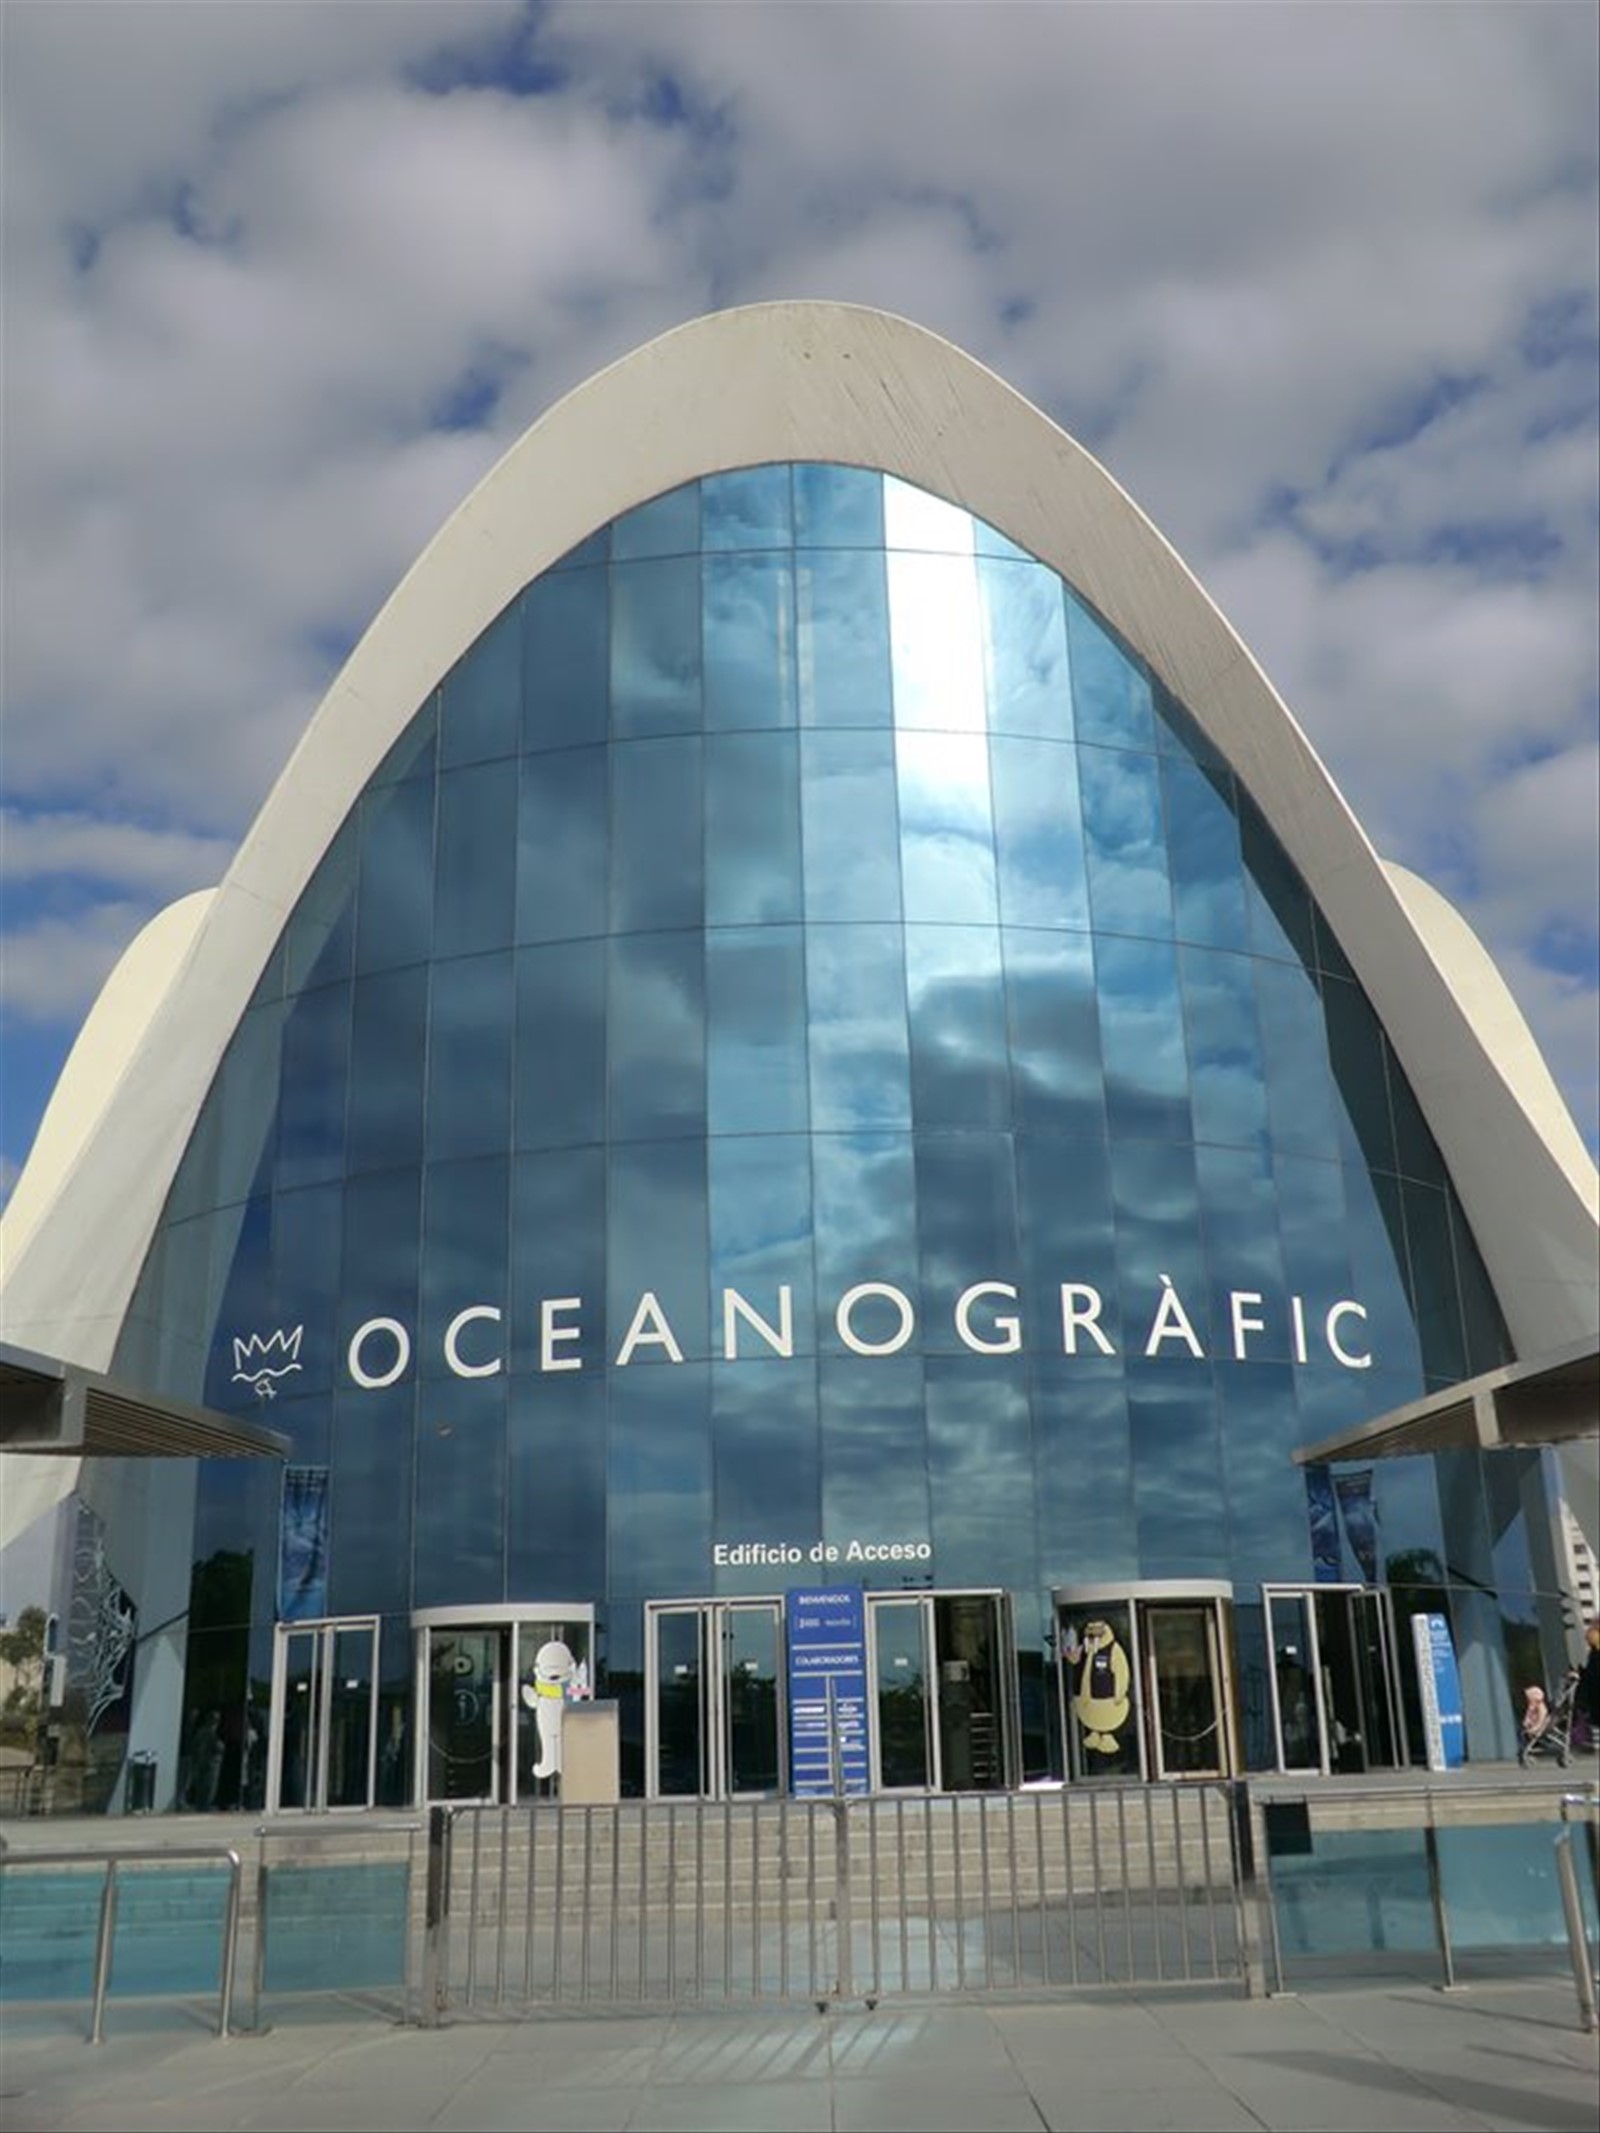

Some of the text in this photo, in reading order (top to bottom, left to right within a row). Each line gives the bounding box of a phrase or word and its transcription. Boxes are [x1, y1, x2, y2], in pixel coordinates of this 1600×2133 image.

[347, 1273, 1373, 1388] OCEANOGRÀFIC
[713, 1540, 932, 1566] Edificio de Acceso
